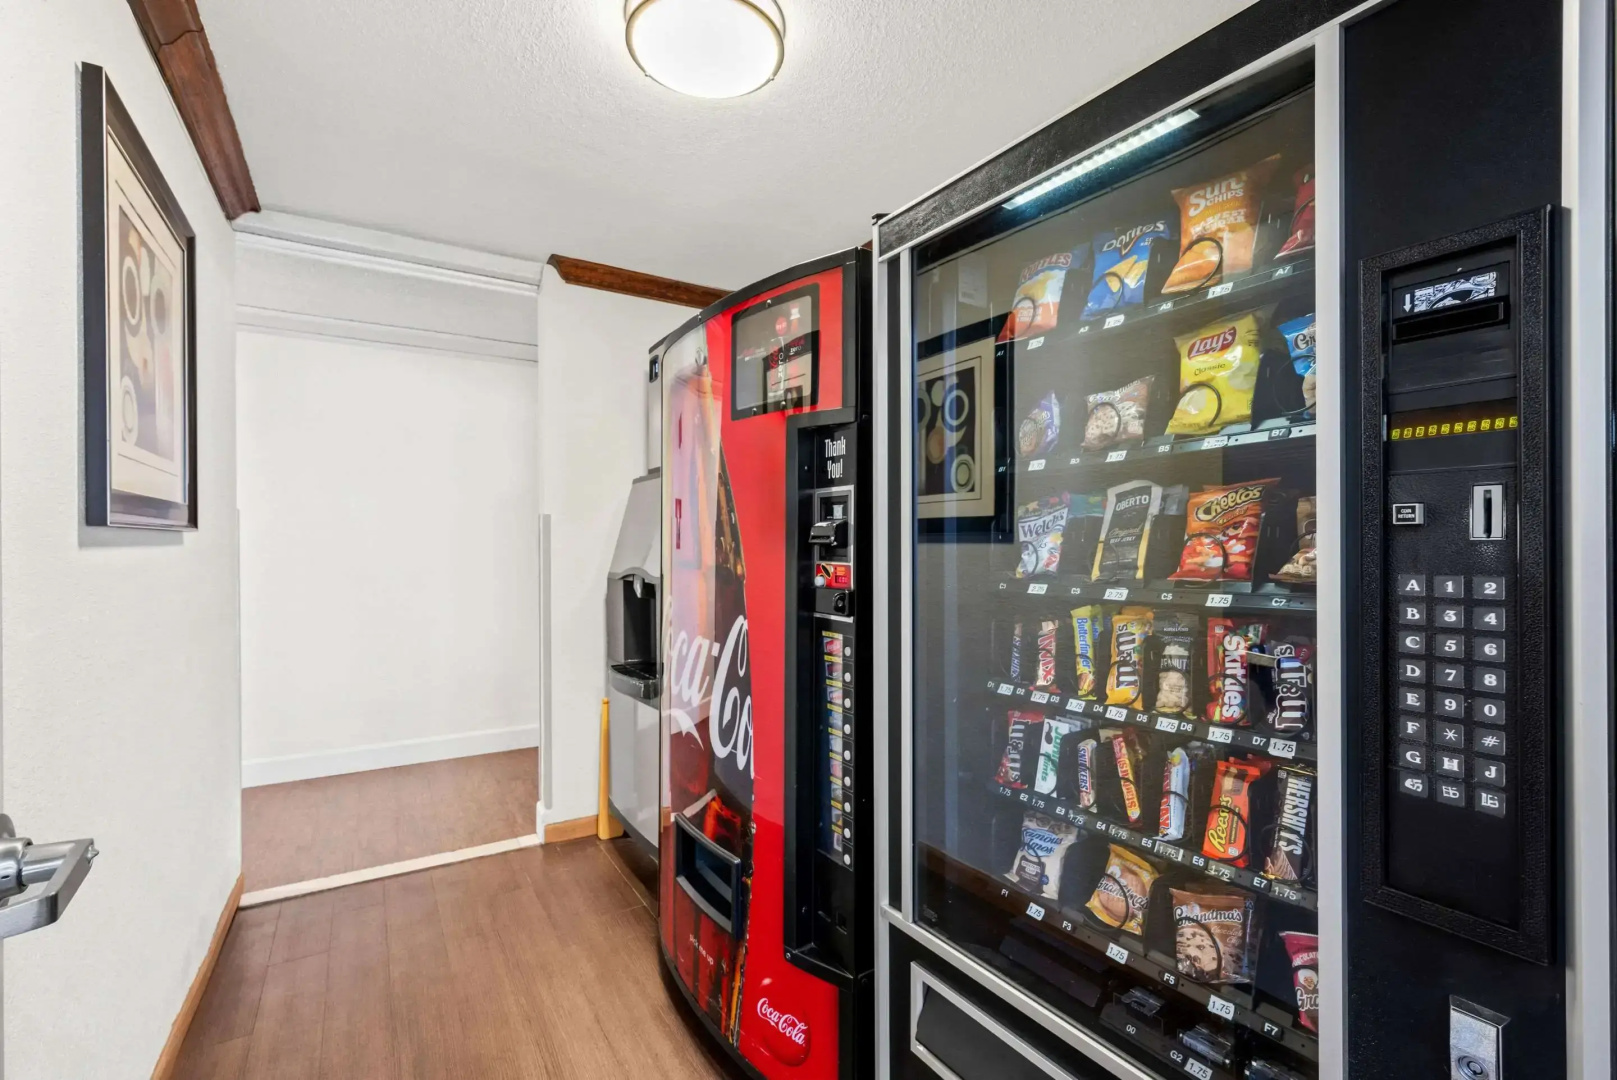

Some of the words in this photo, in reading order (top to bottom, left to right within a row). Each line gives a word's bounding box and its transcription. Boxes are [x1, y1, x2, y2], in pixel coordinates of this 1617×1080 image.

[1188, 176, 1246, 217] Sun
[1206, 188, 1245, 206] CHIPS
[1102, 220, 1166, 252] Doritos
[1275, 266, 1292, 277] A7
[1189, 328, 1234, 357] Lay's
[1271, 429, 1287, 437] B7
[824, 436, 846, 458] Thank
[1158, 445, 1170, 453] B5
[826, 458, 843, 479] You!
[1115, 494, 1150, 512] OBERTO
[1195, 486, 1264, 521] Cheetos
[1020, 511, 1066, 538] Welch's
[1405, 579, 1420, 591] A
[1445, 581, 1454, 593] 1
[1483, 582, 1497, 594] 2
[1106, 590, 1125, 600] 2.75
[1209, 596, 1230, 605] 1.75
[1271, 598, 1287, 607] C7
[1406, 608, 1420, 620] B
[1444, 610, 1457, 622] 3
[1484, 613, 1497, 625] 4
[1405, 637, 1420, 648] C
[1445, 640, 1457, 652] 5
[1484, 643, 1497, 656] 6
[1405, 665, 1421, 677] D
[1444, 669, 1456, 681] 7
[1484, 674, 1497, 686] 8
[1016, 687, 1025, 695] D2
[1032, 693, 1047, 701] 1.75
[1068, 700, 1084, 710] 1.75
[1093, 704, 1104, 713] D4
[1405, 693, 1421, 706] E
[1444, 698, 1457, 711] 9
[1108, 708, 1124, 719] 1.75
[1136, 713, 1149, 722] D5
[1159, 721, 1176, 731] 1.75
[1180, 721, 1193, 732] D6
[1406, 721, 1419, 734] F
[1210, 729, 1230, 741] 1.75
[1252, 735, 1267, 746] D7
[1272, 740, 1295, 754] 1.75
[1405, 751, 1421, 764] G
[1442, 757, 1459, 771] H
[1484, 766, 1497, 779] J
[999, 786, 1012, 797] 1.75
[1031, 799, 1046, 809] 1.75
[1068, 814, 1084, 826] 1.75
[1095, 821, 1106, 831] E4
[1109, 828, 1128, 840] 1.75
[1141, 838, 1152, 848] E5
[1159, 845, 1177, 858] 1.75
[1192, 856, 1205, 867] E6
[1210, 865, 1231, 879] 1.75
[1253, 876, 1267, 889] E7
[1001, 889, 1009, 897] F1
[1274, 886, 1297, 900] 1.75
[1028, 905, 1043, 918] 1.75
[1062, 921, 1072, 931] F3
[1109, 946, 1125, 961] 1.75
[1163, 973, 1175, 985] F5
[1211, 1000, 1231, 1015] 1.75
[1264, 1022, 1278, 1036] F7
[1169, 1050, 1183, 1063] G2
[1189, 1063, 1208, 1078] 1.75
